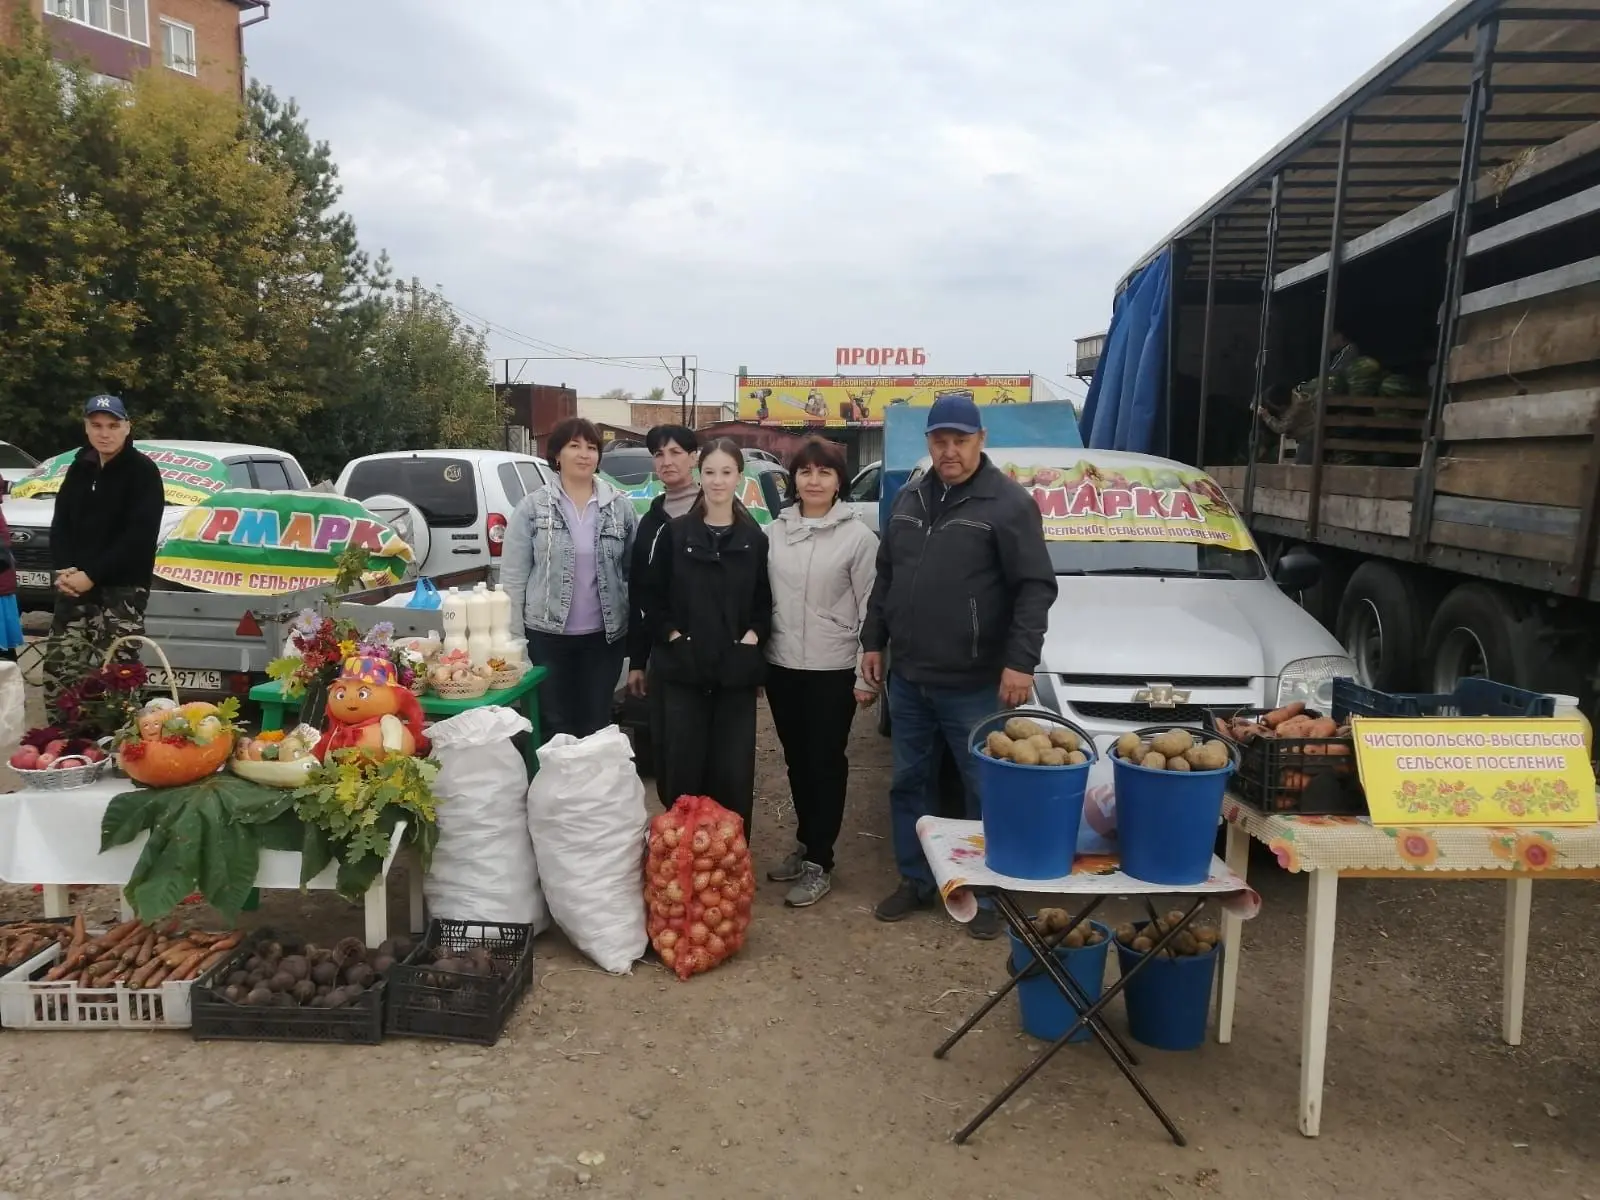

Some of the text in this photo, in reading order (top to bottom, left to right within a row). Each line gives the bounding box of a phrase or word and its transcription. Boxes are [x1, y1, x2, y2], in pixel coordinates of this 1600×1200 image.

[836, 347, 926, 366] ПРОРАБ
[913, 378, 968, 387] ОБОРУДОВАНИЕ
[985, 378, 1021, 387] ЗАПЧАСТИ
[1032, 482, 1206, 523] МАРКА
[168, 507, 402, 557] ЯРМАРК
[1044, 524, 1229, 541] СЕЛЬСКОЕ СЕЛЬСКОЕ ПОСЕЛЕНИЕ
[30, 572, 49, 582] 716
[202, 671, 215, 683] 16
[1396, 756, 1565, 770] СЕЛЬСКОЕ ПОСЕЛЕНИЕ
